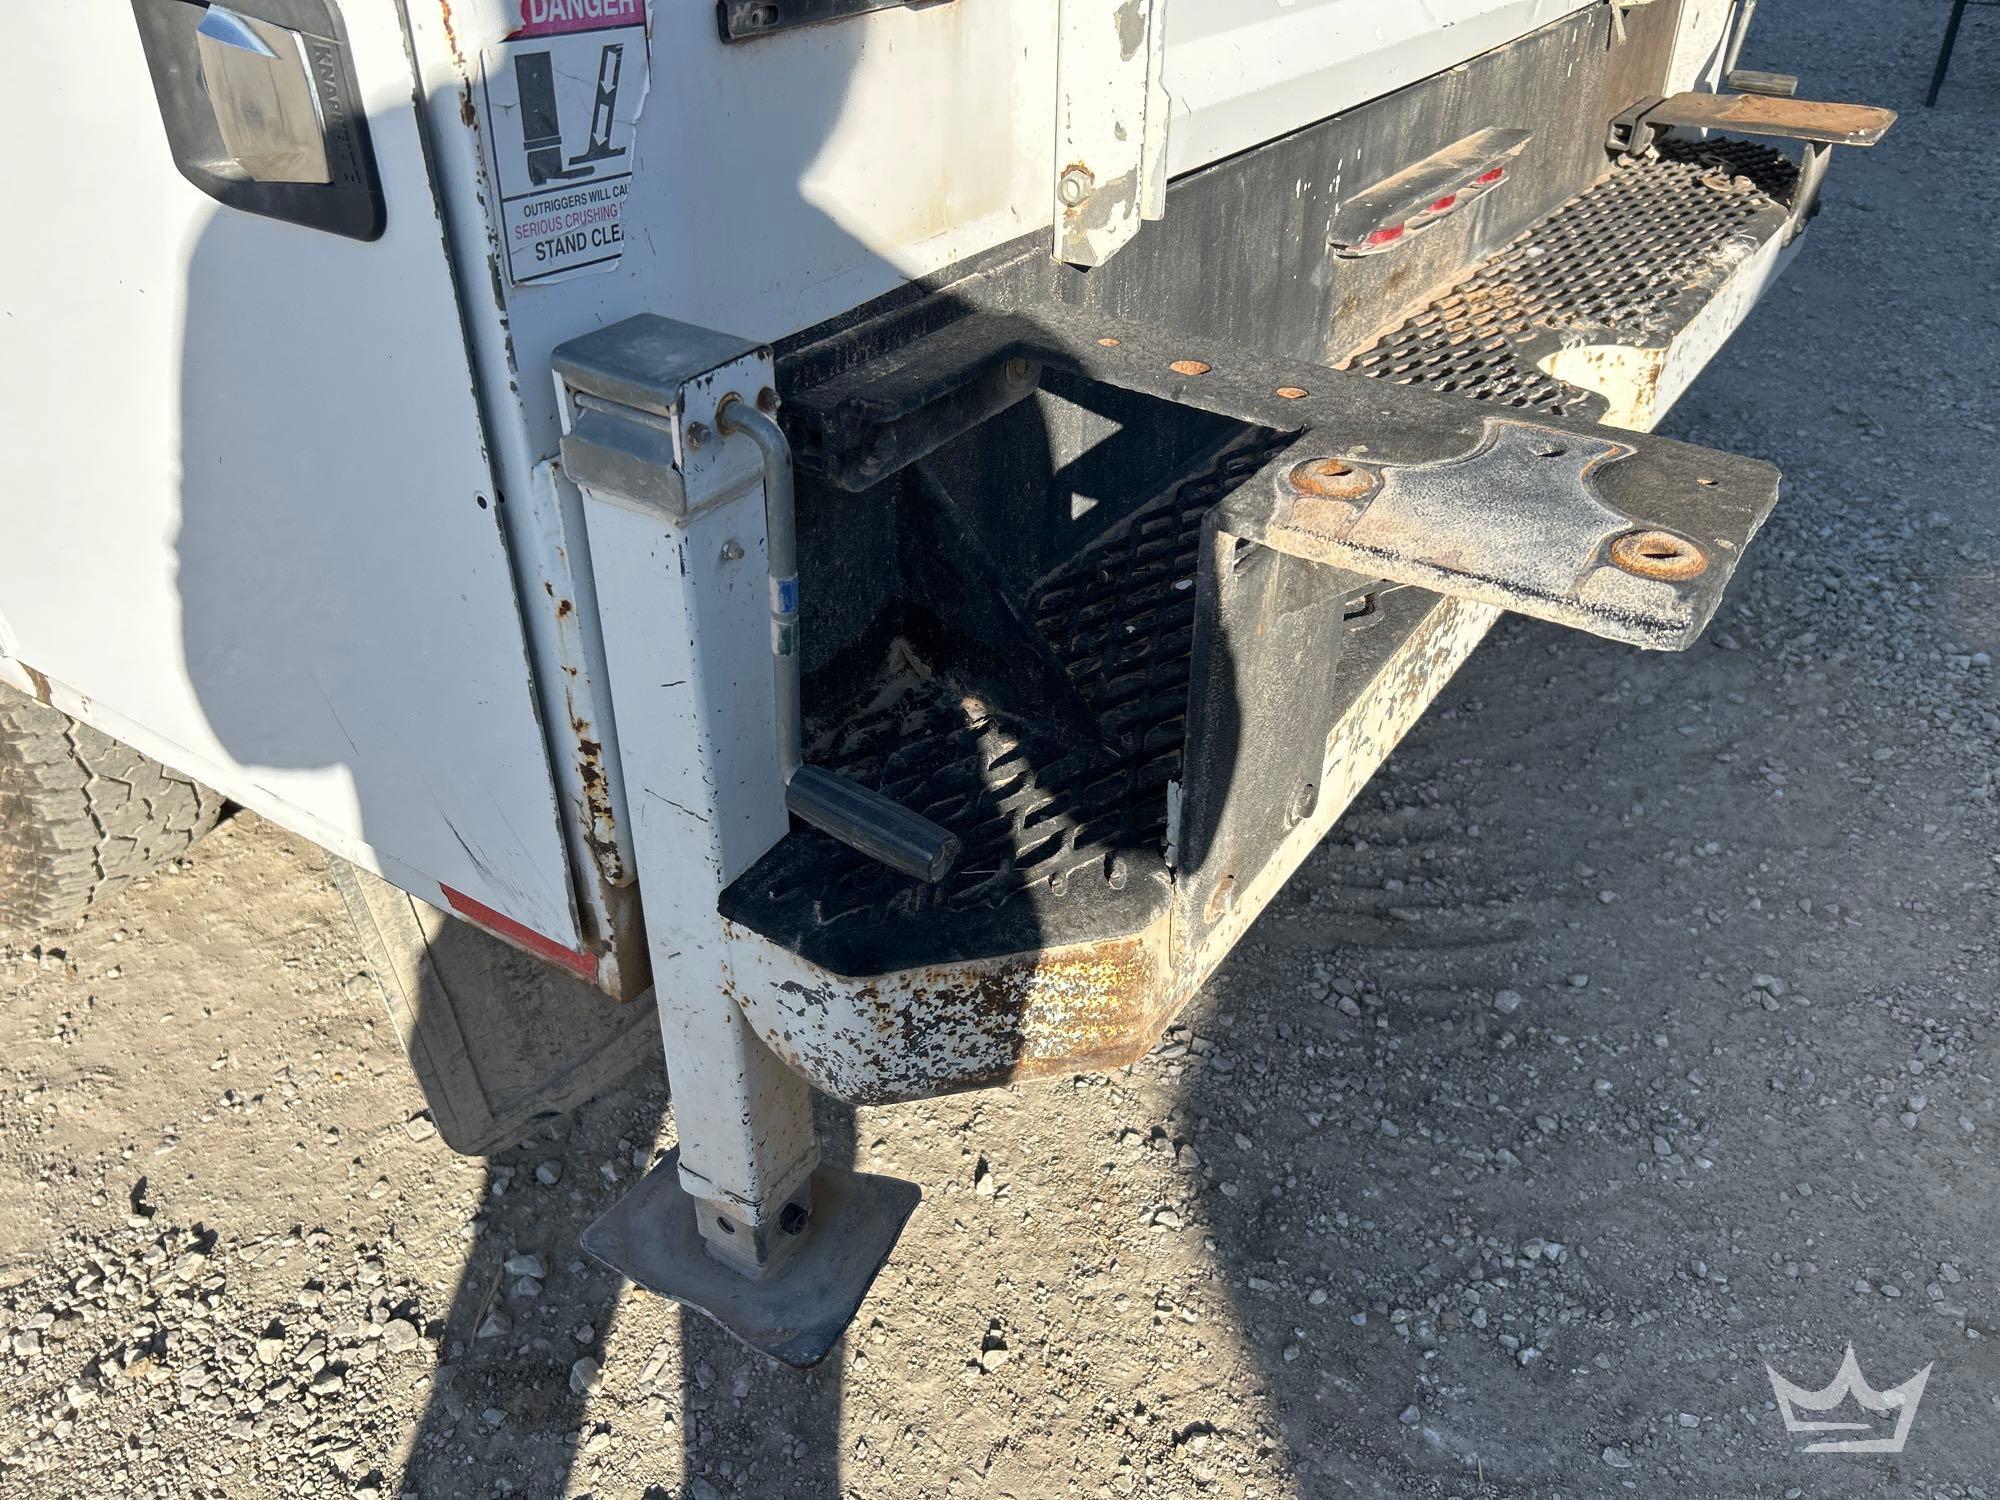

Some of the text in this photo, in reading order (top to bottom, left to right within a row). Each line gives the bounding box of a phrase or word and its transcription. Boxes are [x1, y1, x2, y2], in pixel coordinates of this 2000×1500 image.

[523, 193, 588, 218] OUTRIGGERS
[588, 188, 611, 203] WILL
[515, 216, 563, 240] SERIOUS
[565, 203, 618, 228] CRUSHING
[535, 232, 587, 261] STAND
